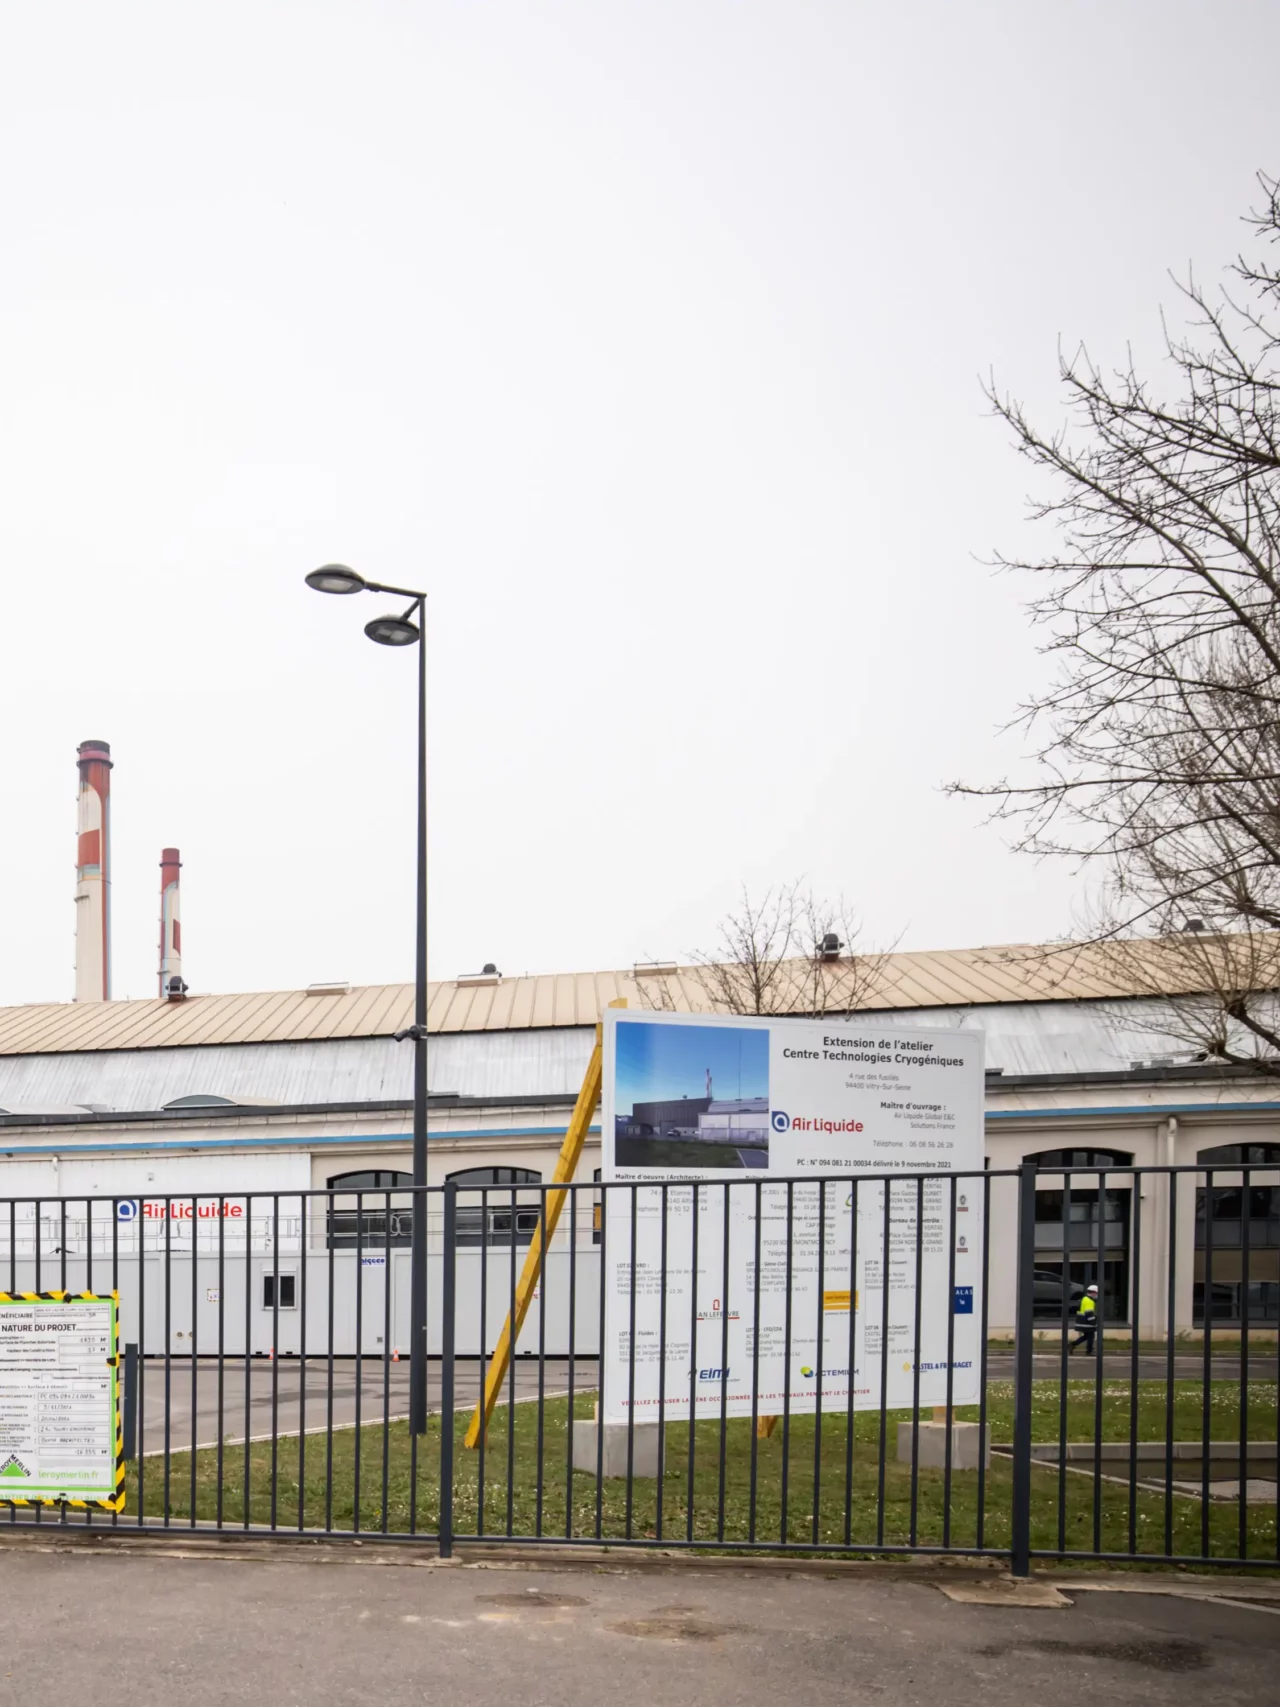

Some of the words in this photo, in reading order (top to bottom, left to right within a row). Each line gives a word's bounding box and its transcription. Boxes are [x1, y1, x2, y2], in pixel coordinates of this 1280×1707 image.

[823, 1036, 875, 1048] Extension
[878, 1039, 891, 1049] de
[894, 1040, 934, 1051] l'atelier
[783, 1048, 820, 1059] Centre
[822, 1050, 892, 1064] Technologies
[895, 1053, 964, 1067] Cryogéniques
[880, 1102, 904, 1110] Maître
[906, 1103, 942, 1112] d'ouvrage
[792, 1117, 812, 1131] Air
[814, 1119, 864, 1134] Liquide
[873, 1140, 903, 1148] Téléphone
[853, 1159, 872, 1167] 00034
[906, 1160, 936, 1168] novembre
[141, 1203, 166, 1218] Air
[940, 1361, 972, 1369] FRMAGET
[709, 1393, 750, 1402] OCCSIONNÉE
[10, 1453, 32, 1477] MERLIN
